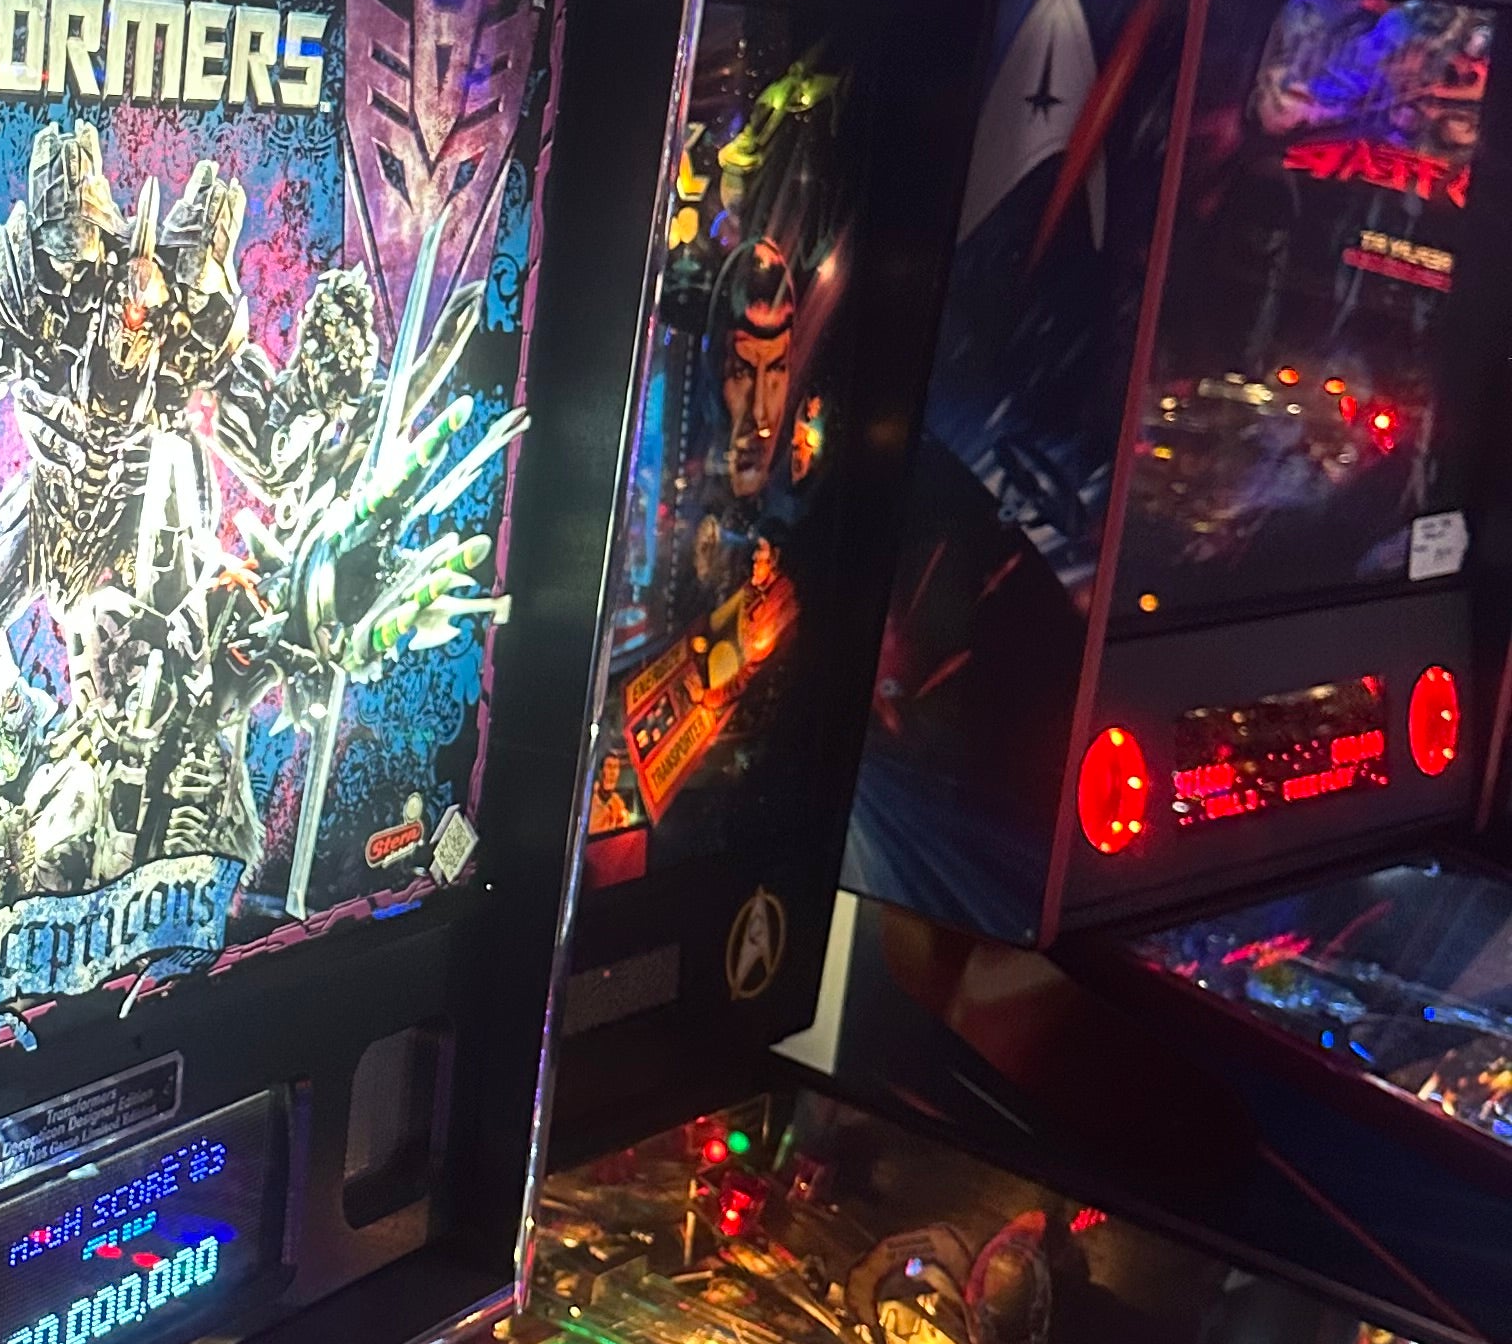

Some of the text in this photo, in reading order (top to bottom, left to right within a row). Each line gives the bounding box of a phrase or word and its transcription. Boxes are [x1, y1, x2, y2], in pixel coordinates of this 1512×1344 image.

[371, 827, 419, 855] Stern
[46, 1086, 118, 1125] Transformers
[1, 1123, 66, 1158] Decepticon
